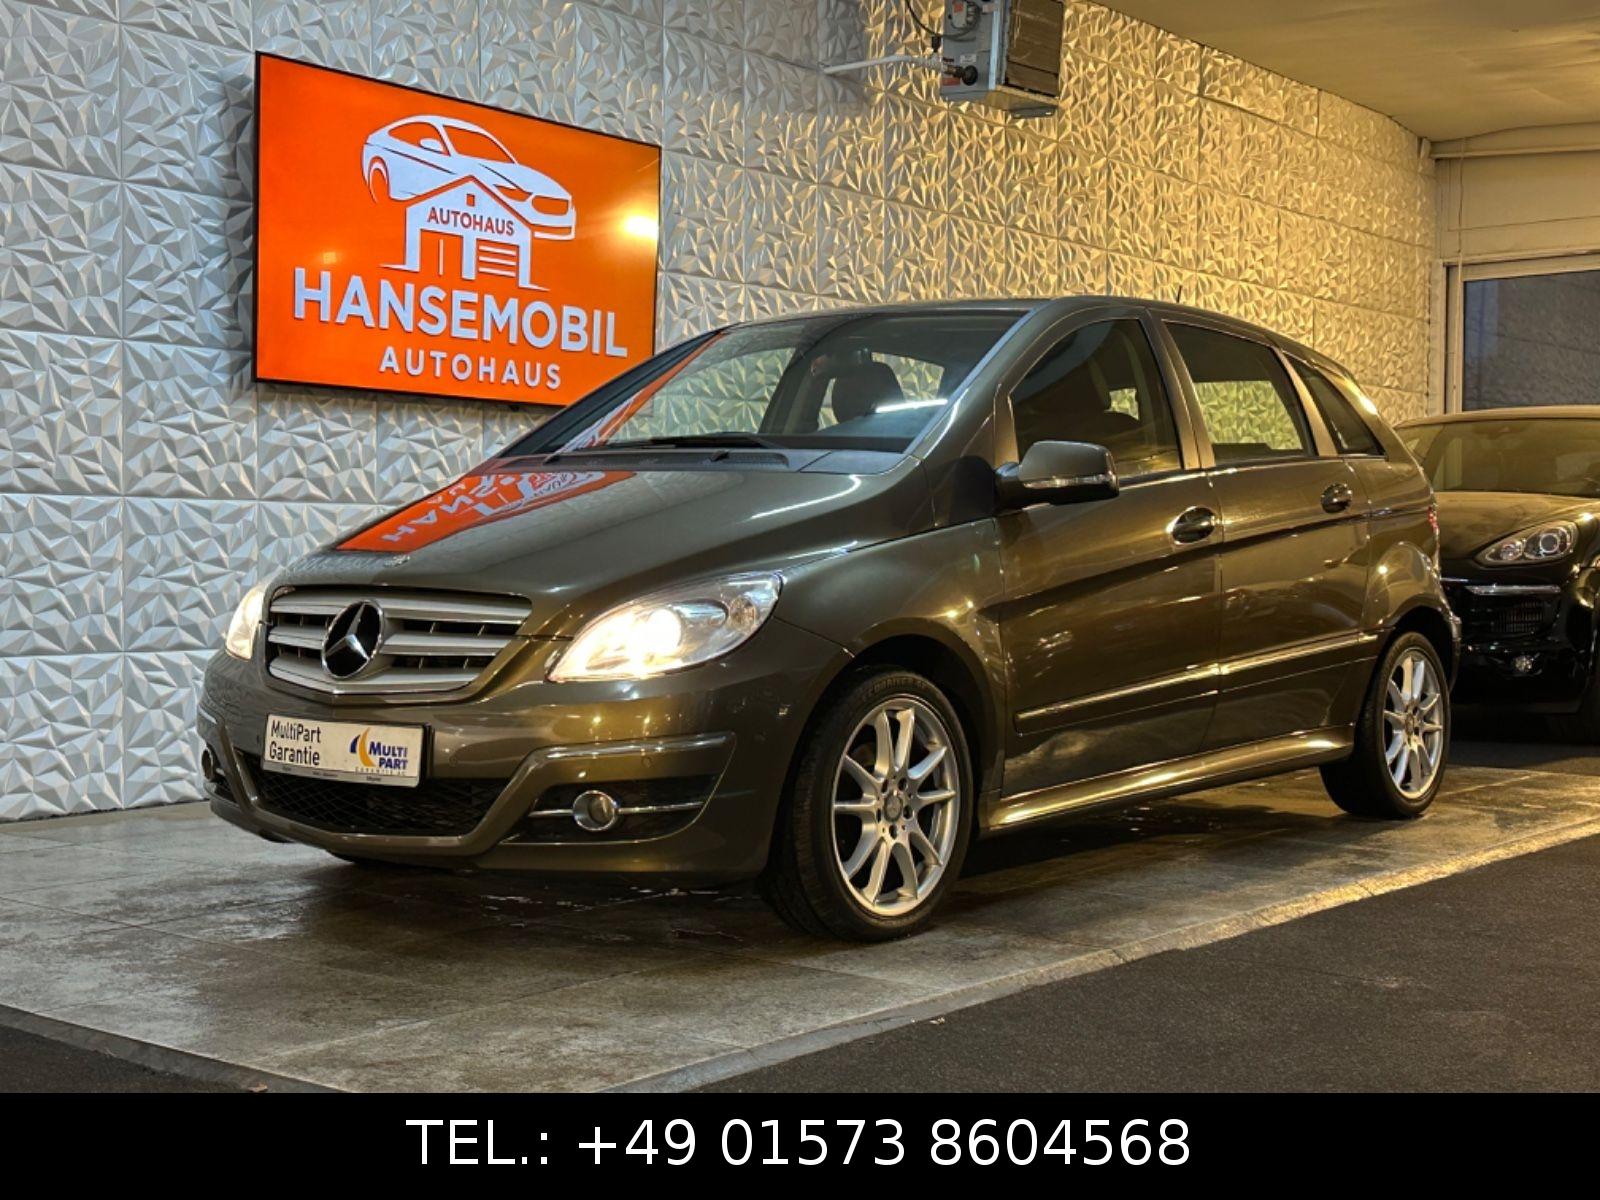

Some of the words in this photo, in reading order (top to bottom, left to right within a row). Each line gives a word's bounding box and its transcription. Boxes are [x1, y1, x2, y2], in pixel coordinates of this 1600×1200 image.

[427, 206, 516, 237] AUTOHAUS
[294, 266, 628, 358] HANSEMOBIL
[379, 345, 562, 389] AUTOHAUS
[271, 719, 321, 743] MultiPart
[270, 740, 320, 766] Garantie
[369, 741, 408, 757] MULTI
[379, 757, 408, 770] PART
